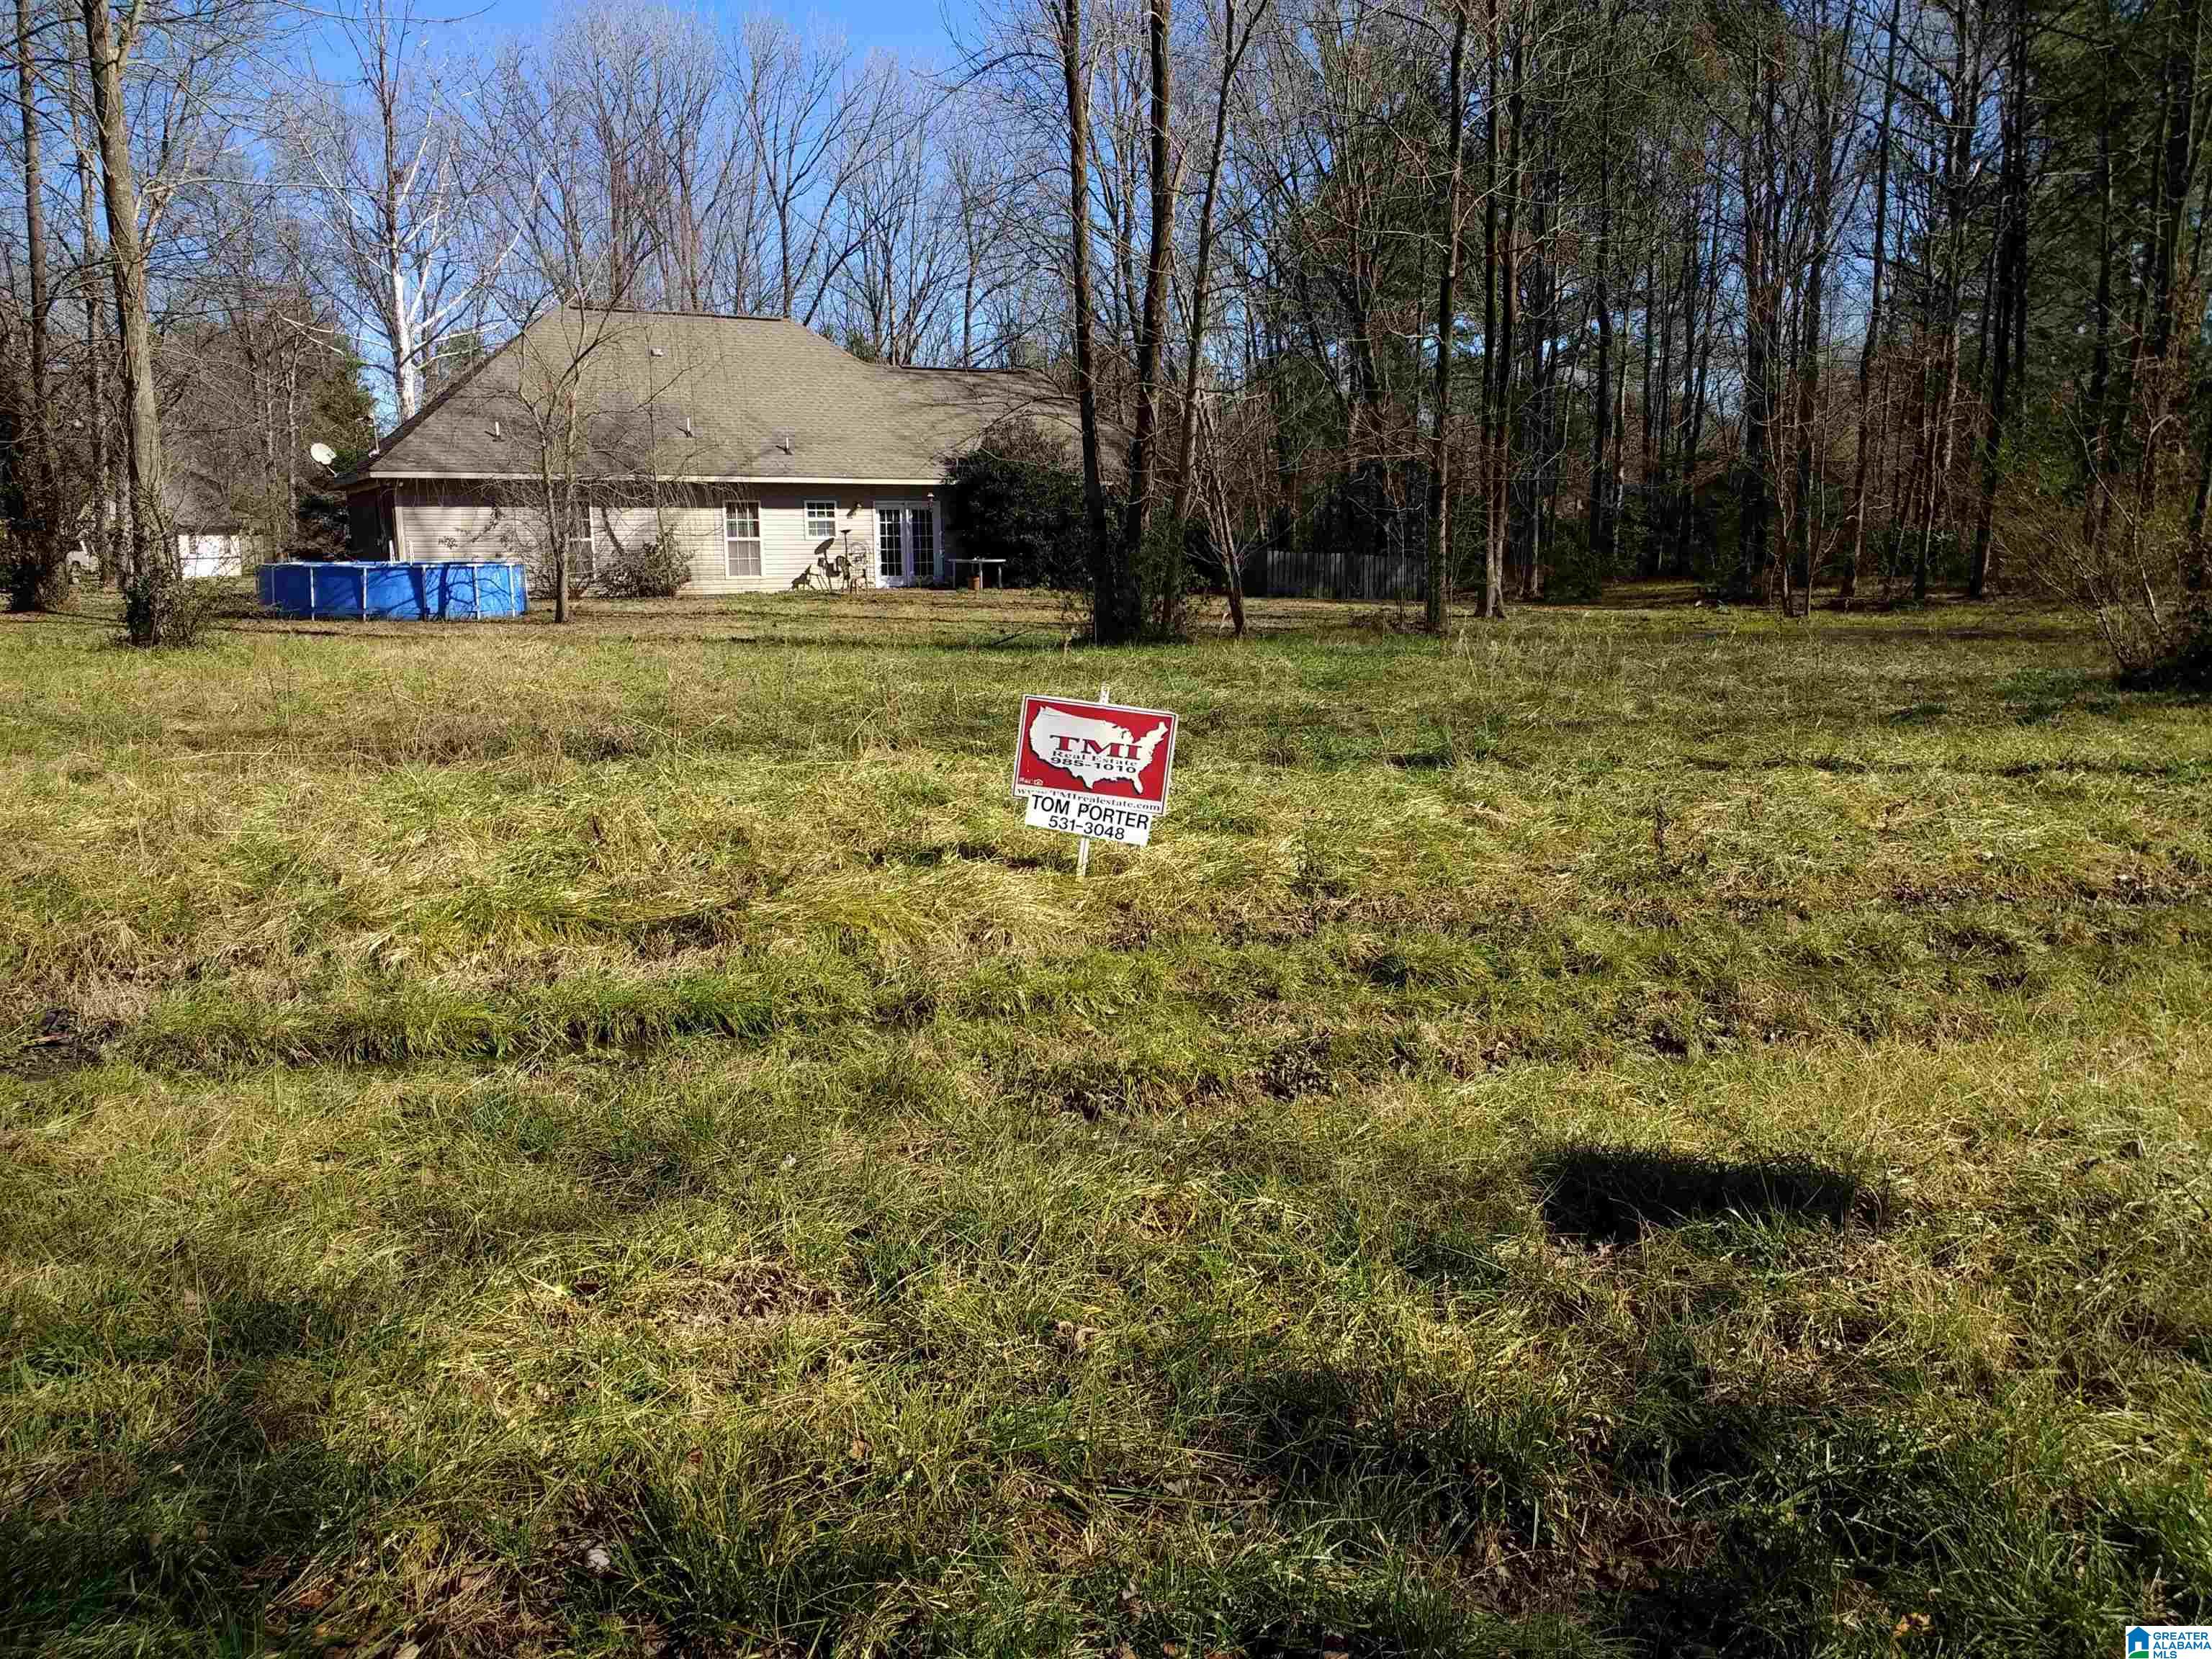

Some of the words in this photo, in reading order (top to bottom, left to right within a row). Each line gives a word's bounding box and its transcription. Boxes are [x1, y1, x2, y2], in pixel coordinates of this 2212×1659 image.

[1049, 734, 1142, 760] TMI
[1052, 750, 1084, 760] Real
[1090, 755, 1137, 766] Estate
[1049, 757, 1137, 773] 985-1010
[1032, 795, 1070, 815] TOM
[1078, 804, 1149, 830] PORTER
[1048, 816, 1125, 840] 531-3048
